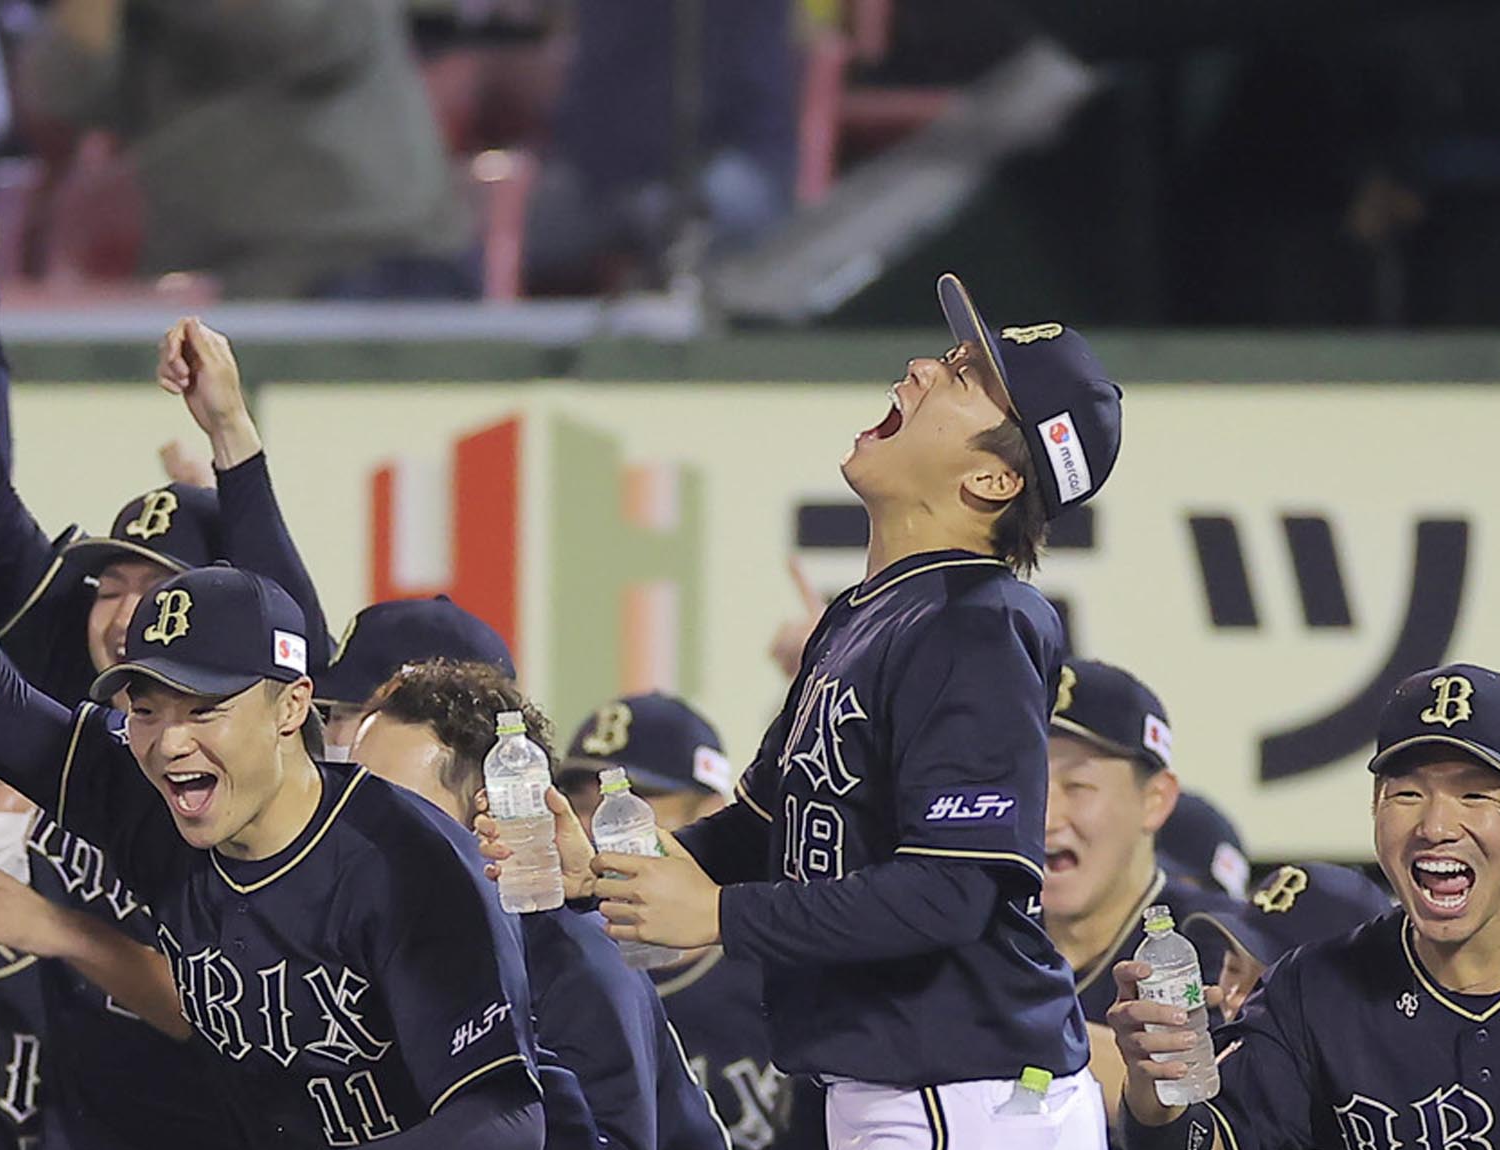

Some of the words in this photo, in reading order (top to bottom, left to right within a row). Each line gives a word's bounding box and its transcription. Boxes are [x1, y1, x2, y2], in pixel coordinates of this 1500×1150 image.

[126, 490, 179, 540] B
[144, 589, 193, 646] B
[1420, 675, 1475, 729] B
[784, 793, 845, 887] 18
[1254, 865, 1309, 914] B
[308, 1070, 401, 1147] 11
